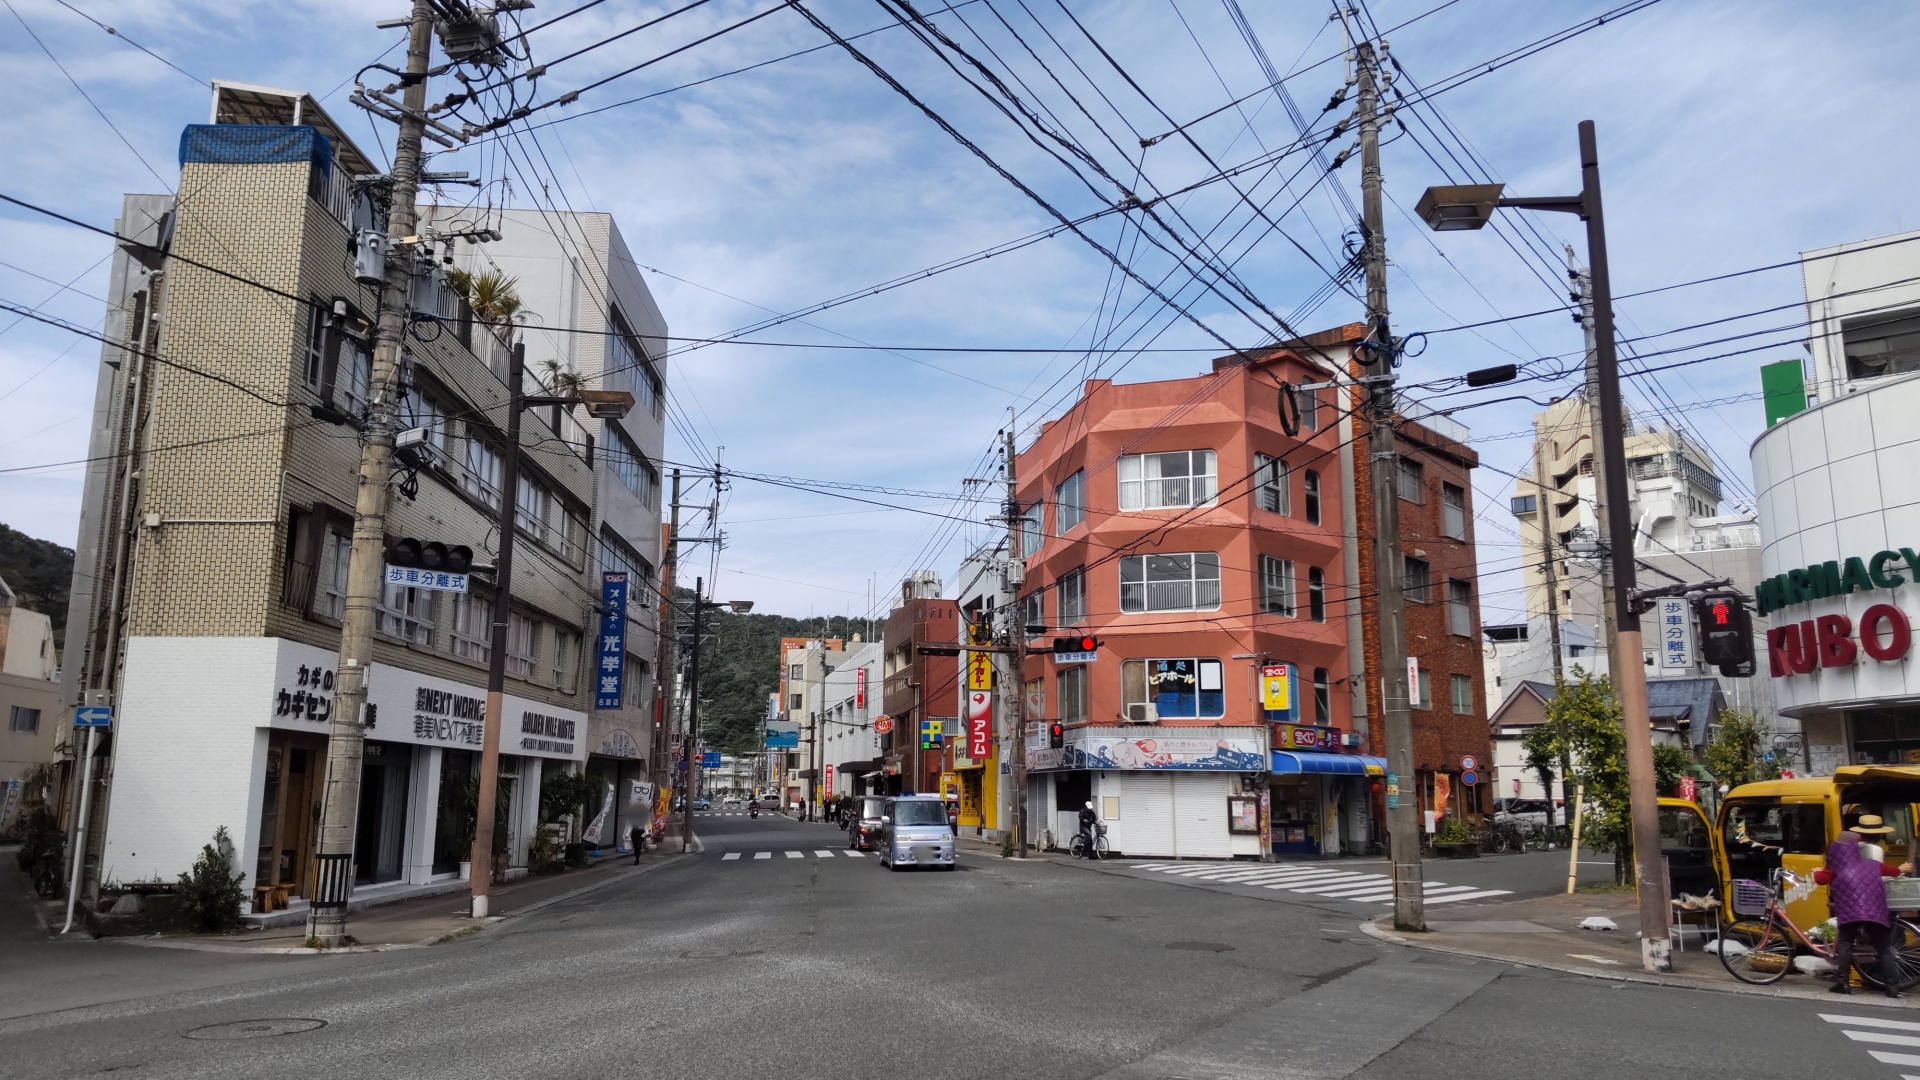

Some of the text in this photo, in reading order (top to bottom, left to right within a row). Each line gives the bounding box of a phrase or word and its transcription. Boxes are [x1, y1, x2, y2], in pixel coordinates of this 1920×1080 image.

[389, 568, 465, 589] 歩車分離式
[1665, 602, 1687, 665] 歩車分離式
[1767, 604, 1911, 678] KUBO
[1057, 652, 1096, 661] 歩車分離式
[425, 688, 453, 716] NEXT
[453, 694, 486, 721] WORKS
[974, 720, 986, 754] アコム
[1295, 731, 1315, 744] 宝くじ
[1464, 759, 1474, 767] 30
